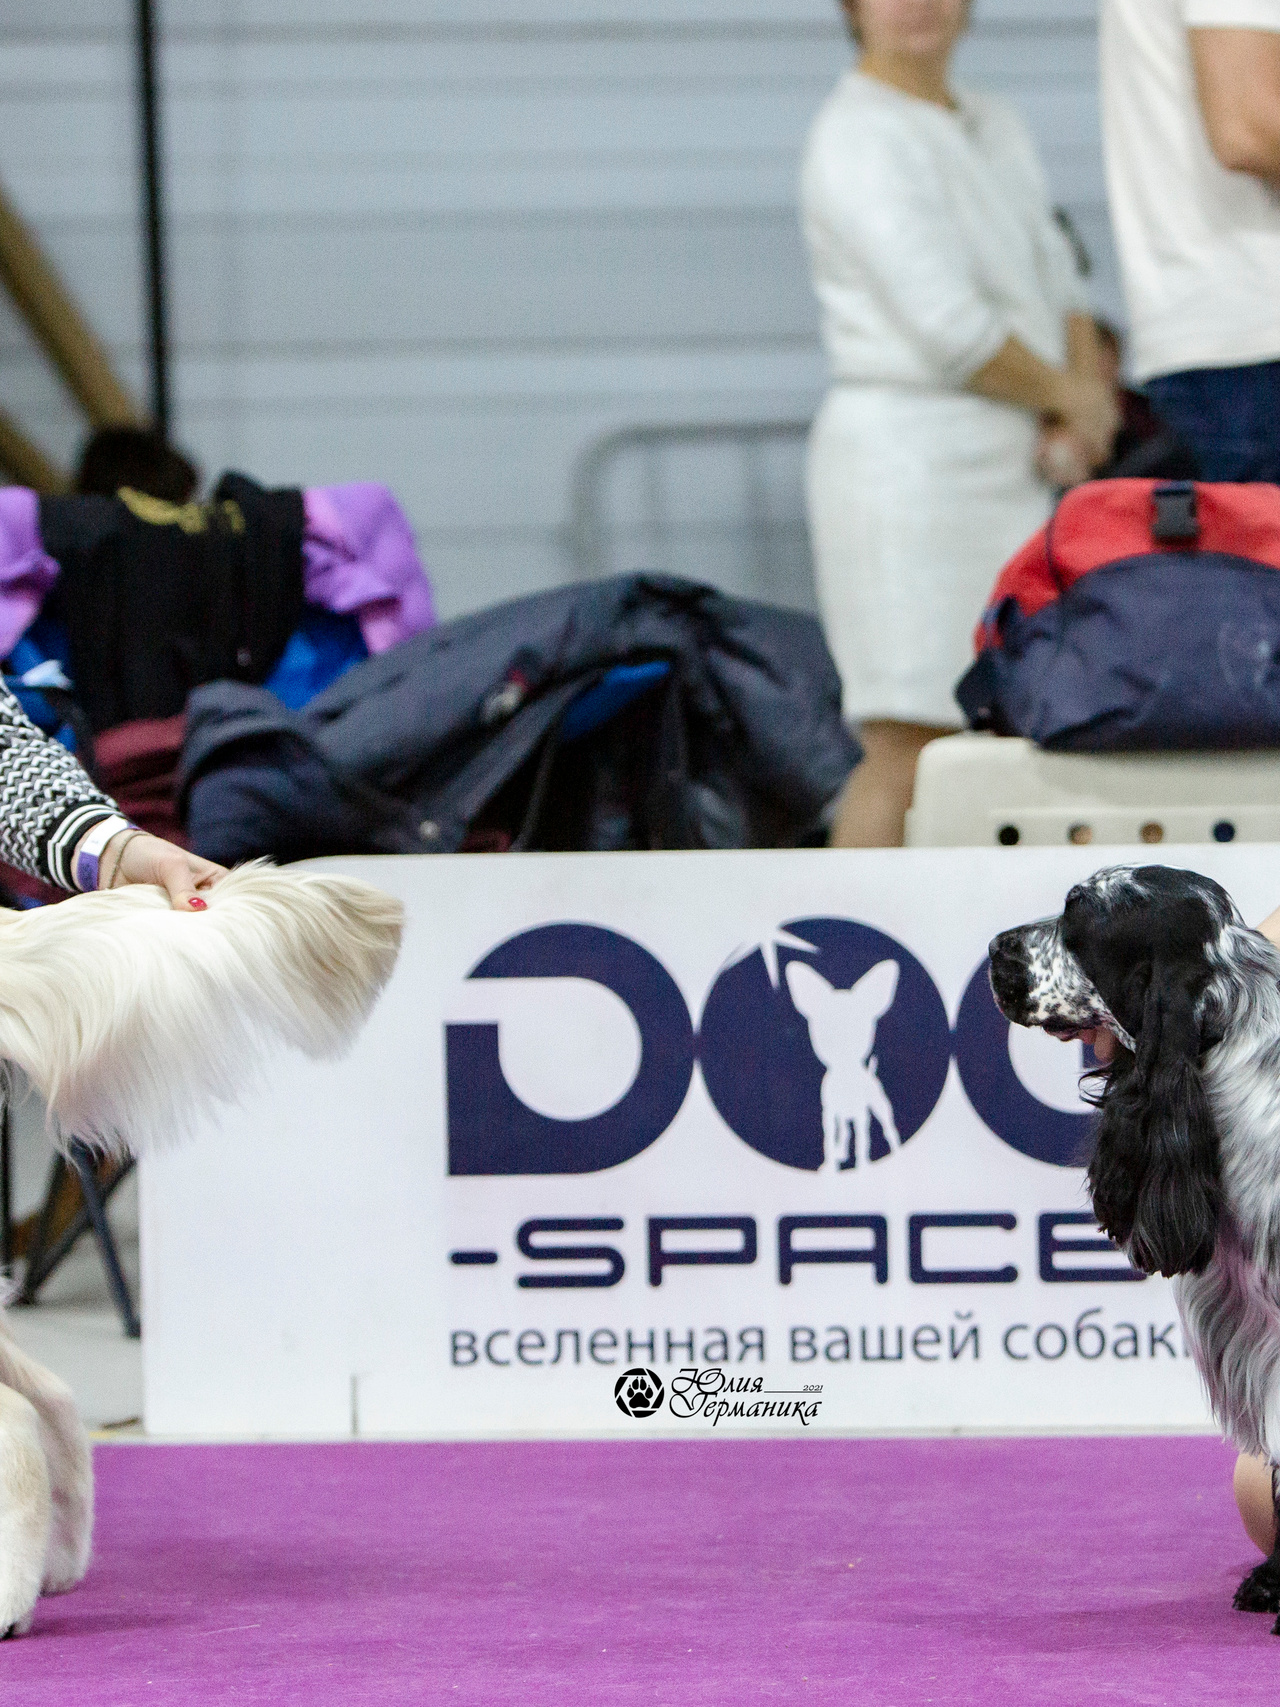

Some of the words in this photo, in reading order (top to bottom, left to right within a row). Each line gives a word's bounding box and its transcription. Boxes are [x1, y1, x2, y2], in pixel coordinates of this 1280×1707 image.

[450, 1326, 766, 1367] вселенная
[788, 1312, 982, 1362] вашей
[1003, 1306, 1192, 1360] собак
